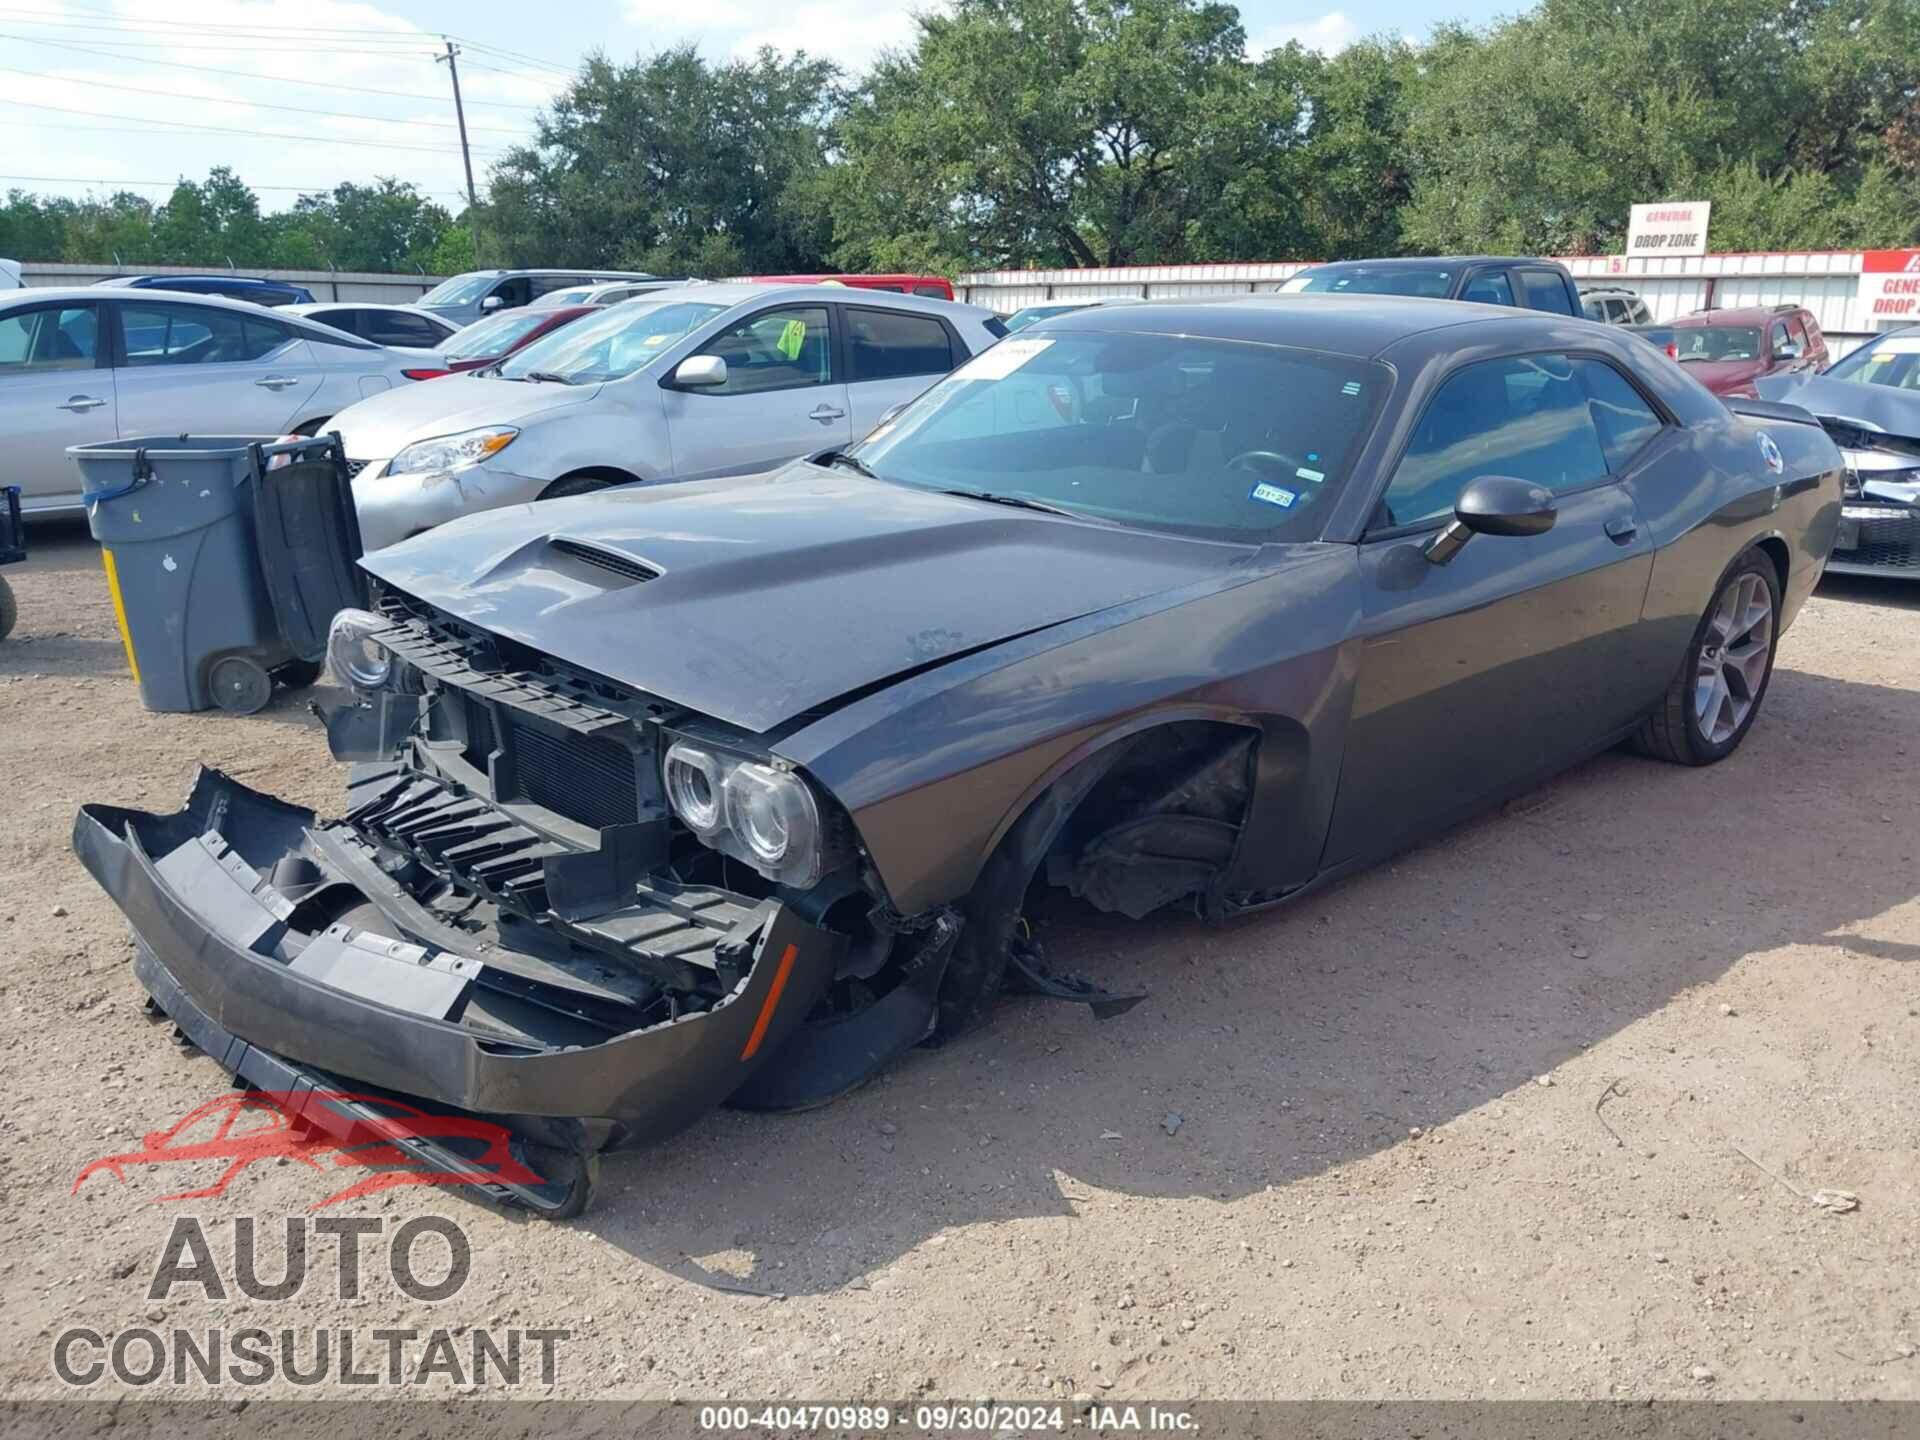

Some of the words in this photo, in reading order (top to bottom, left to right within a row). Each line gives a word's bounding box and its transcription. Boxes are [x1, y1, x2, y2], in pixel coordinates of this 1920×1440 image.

[1634, 234, 1668, 248] DROP
[1668, 233, 1699, 247] ZONE
[1612, 258, 1621, 273] 5
[1873, 298, 1916, 313] DROP
